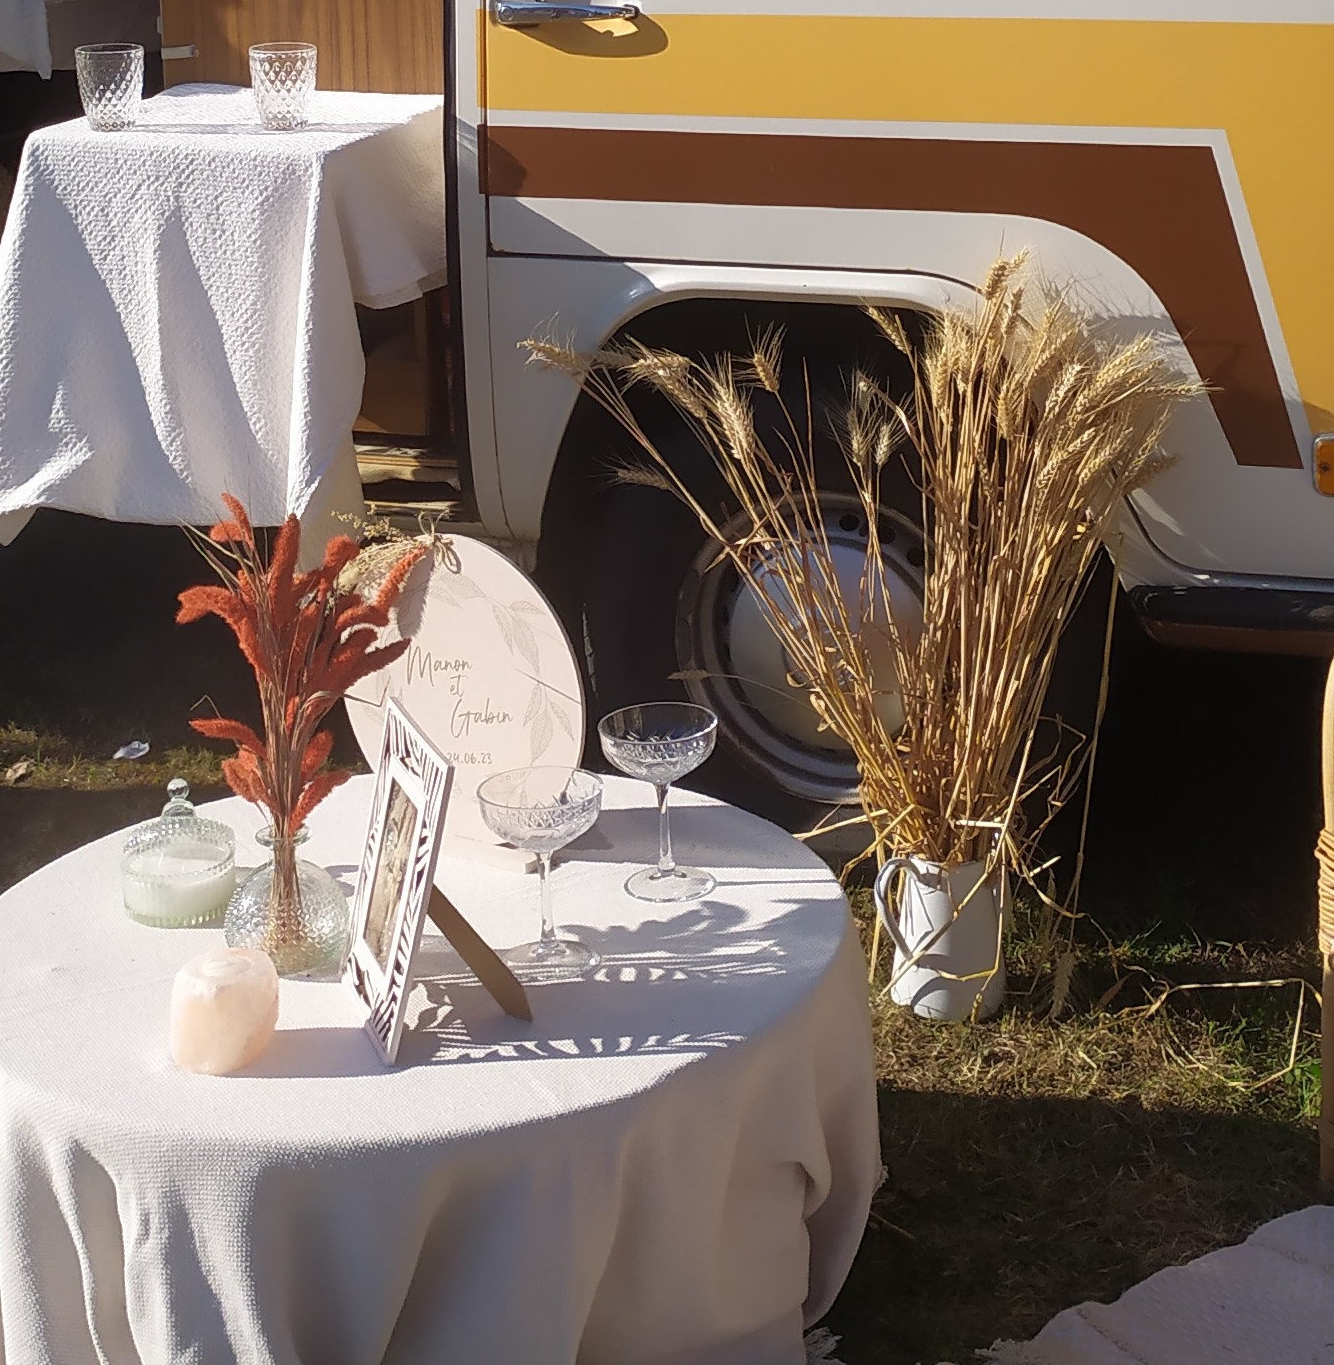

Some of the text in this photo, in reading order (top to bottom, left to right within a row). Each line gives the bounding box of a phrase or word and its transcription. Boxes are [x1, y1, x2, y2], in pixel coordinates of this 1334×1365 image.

[407, 645, 473, 688] Manon
[450, 674, 468, 698] et
[450, 697, 514, 739] Gabin
[447, 752, 493, 765] 24.06.23
